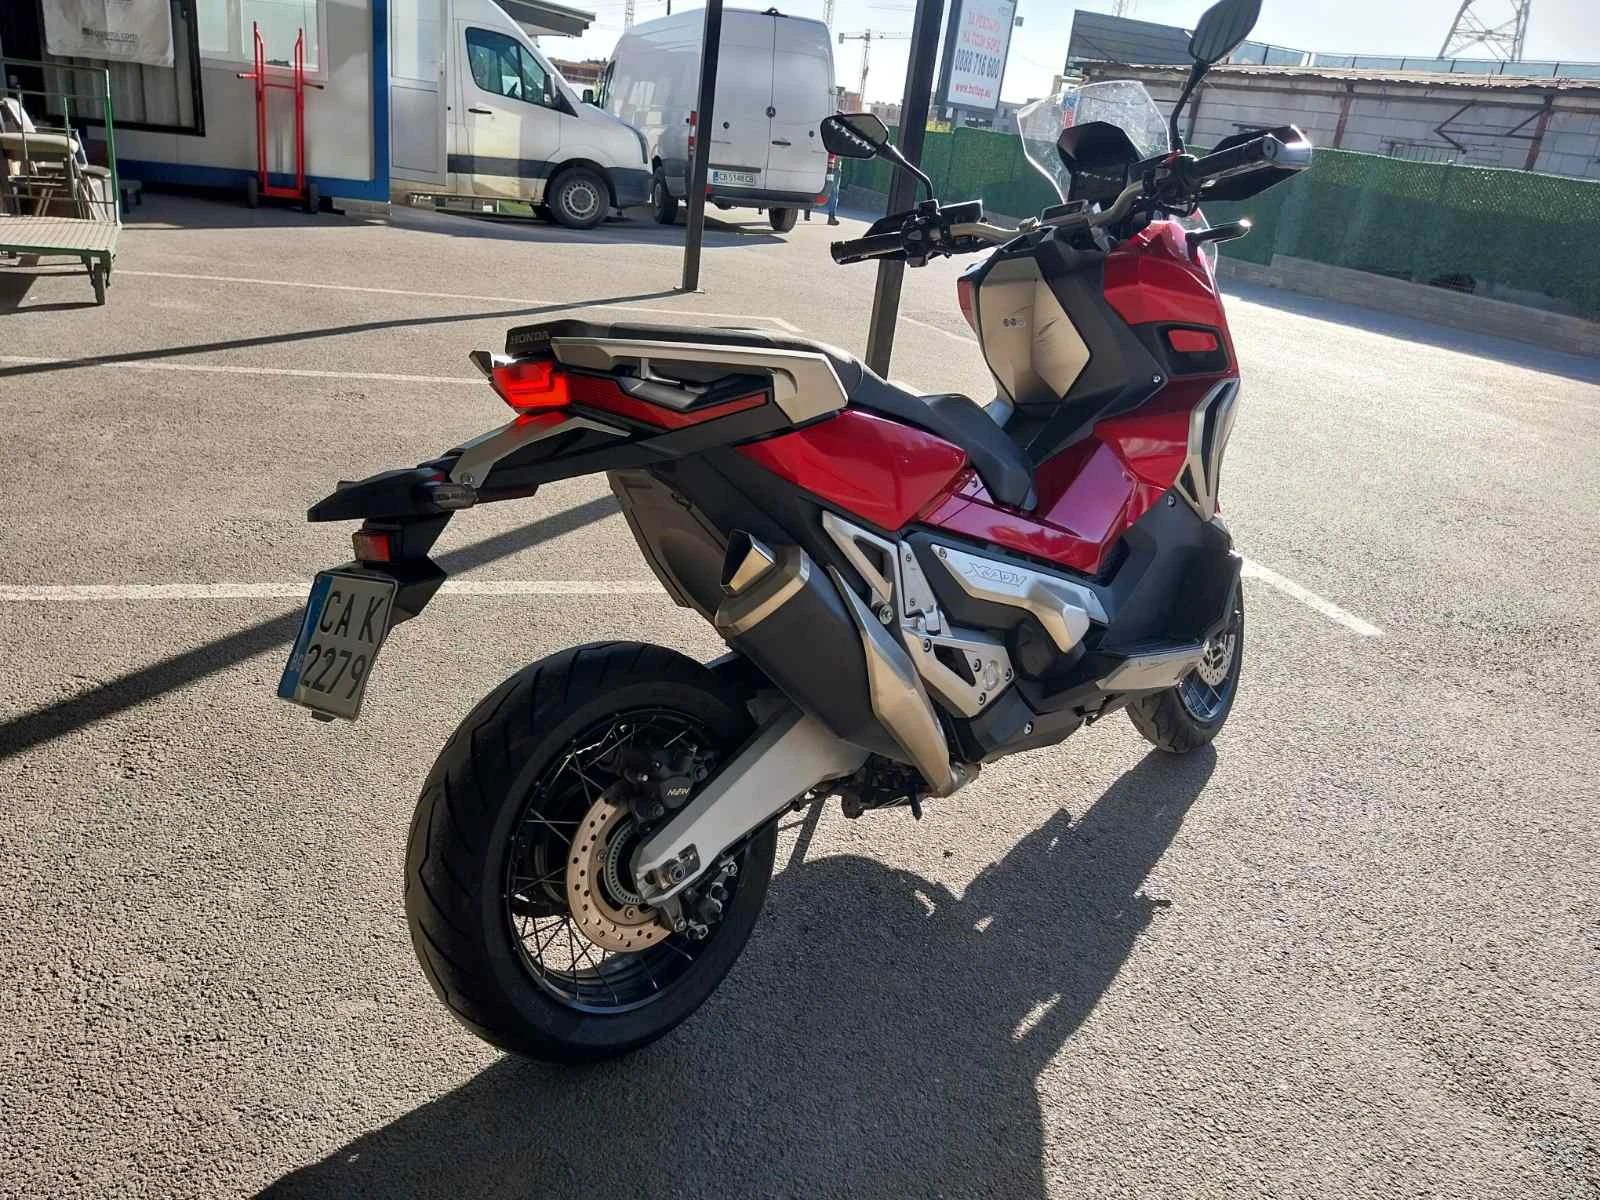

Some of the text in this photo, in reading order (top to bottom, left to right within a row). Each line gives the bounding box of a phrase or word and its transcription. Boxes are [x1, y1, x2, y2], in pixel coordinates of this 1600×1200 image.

[510, 331, 550, 344] HONDA
[319, 590, 385, 644] CA K
[300, 644, 367, 700] 2279
